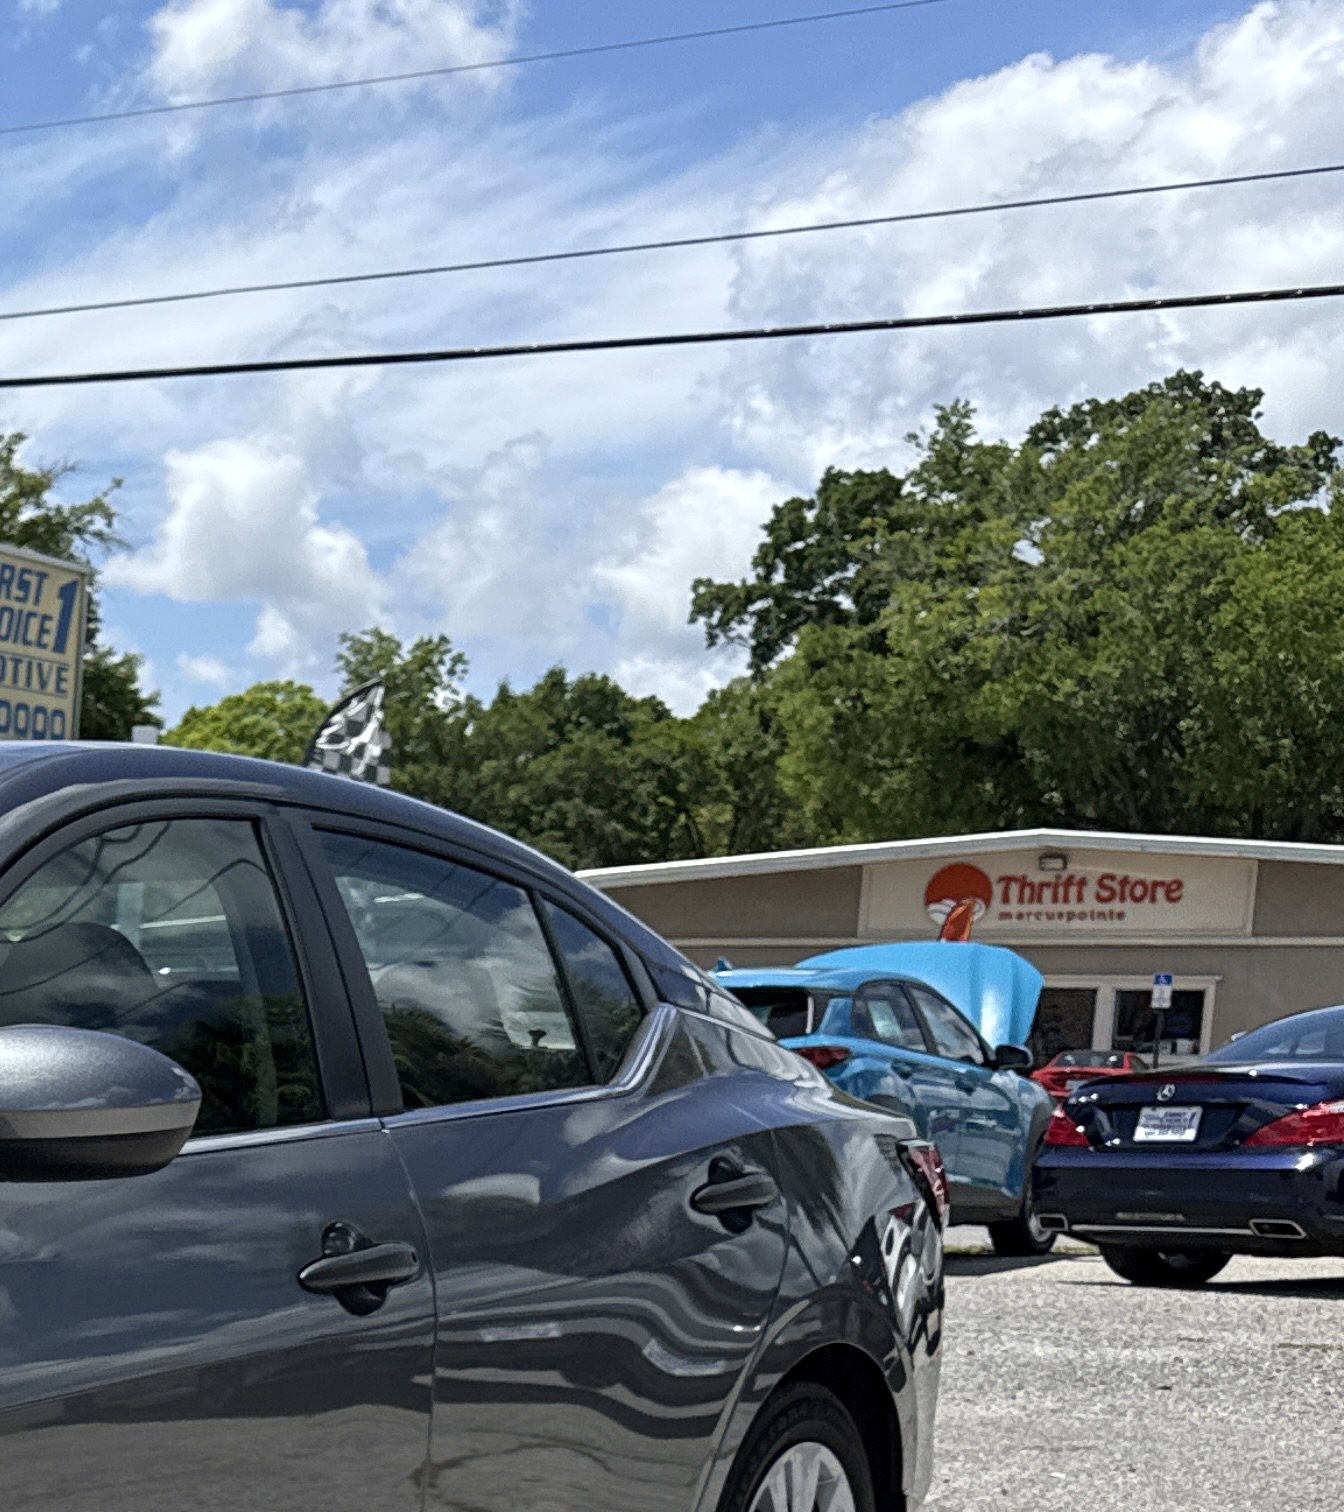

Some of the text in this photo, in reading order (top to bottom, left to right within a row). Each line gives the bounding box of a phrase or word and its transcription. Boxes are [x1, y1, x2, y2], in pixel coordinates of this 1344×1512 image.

[52, 580, 78, 654] 1
[996, 873, 1184, 905] Thrift Store
